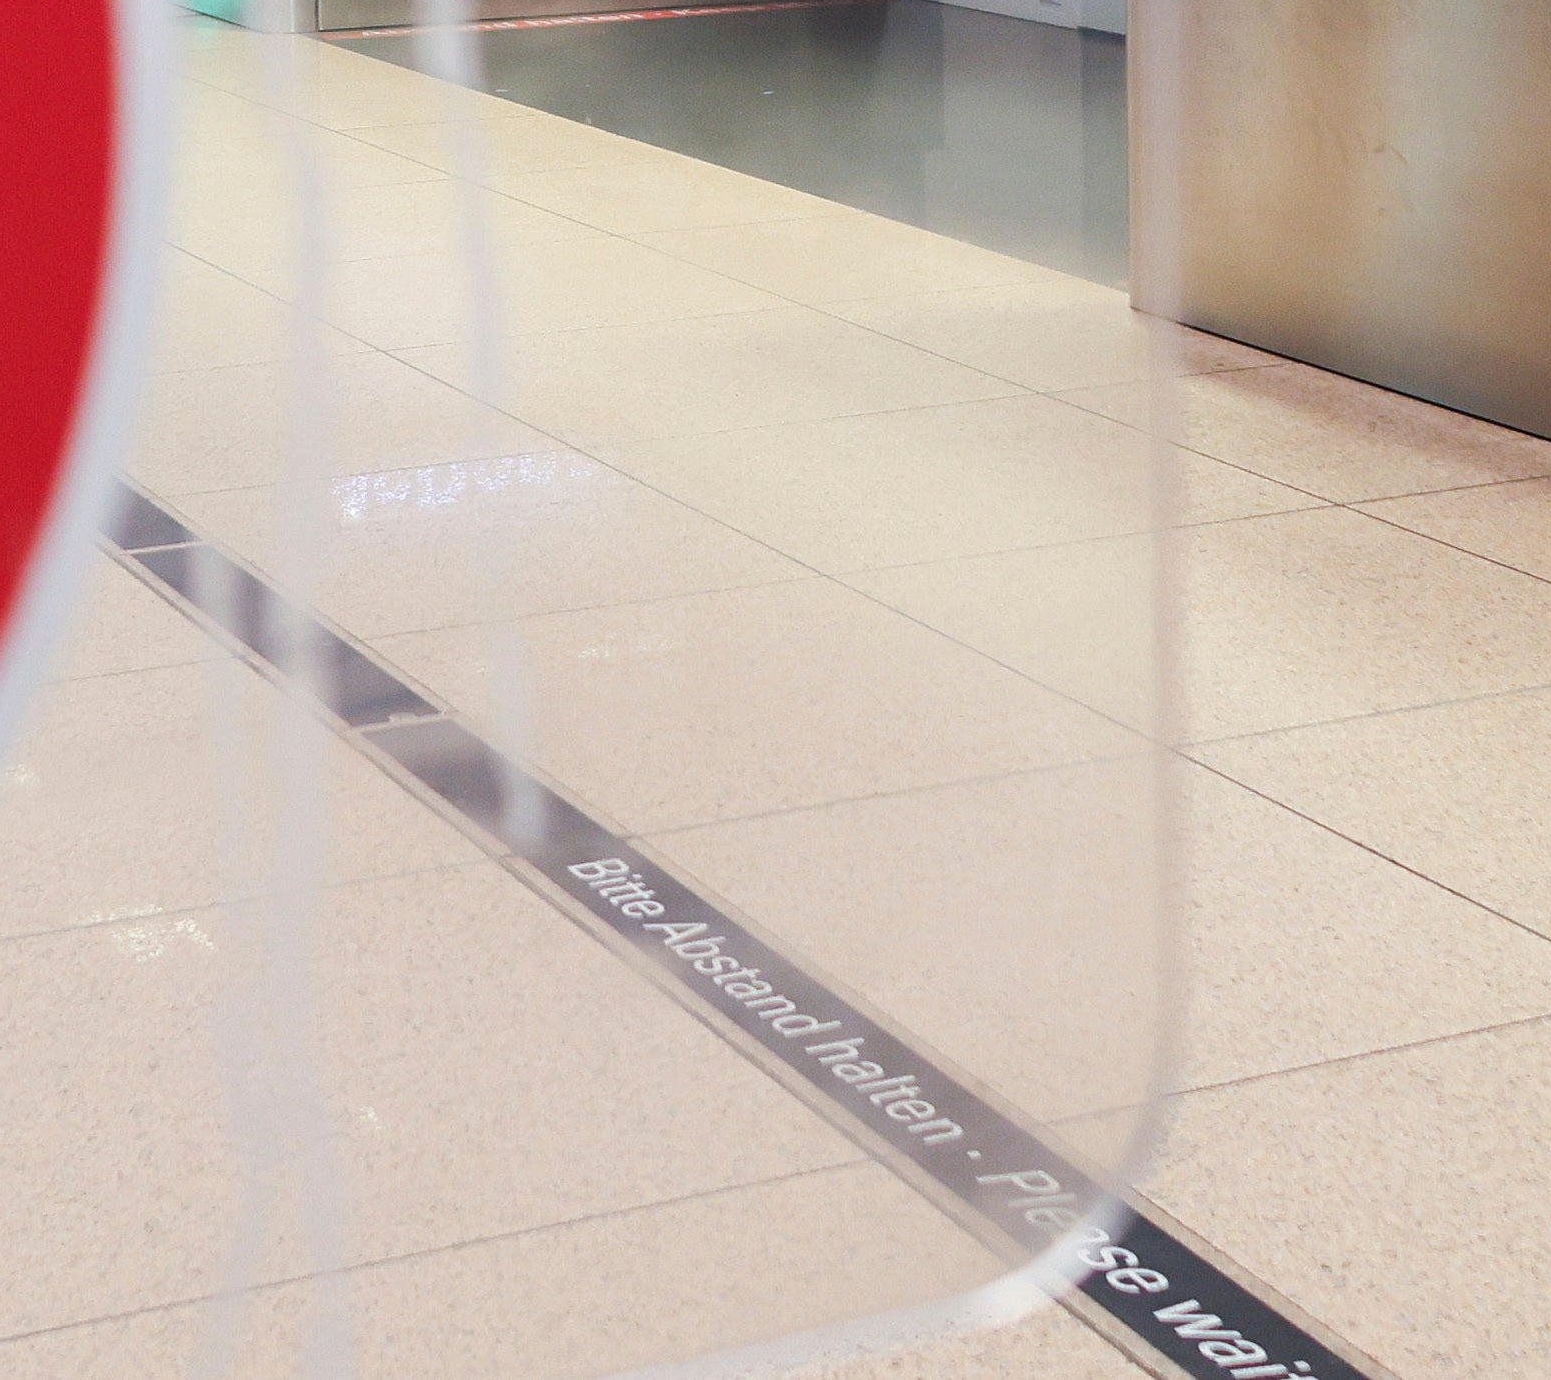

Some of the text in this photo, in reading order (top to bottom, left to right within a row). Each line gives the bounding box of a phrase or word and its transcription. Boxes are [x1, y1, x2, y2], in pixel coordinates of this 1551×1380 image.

[566, 857, 665, 922] Bitte
[645, 919, 842, 1041] Abstand
[805, 1036, 967, 1151] halten
